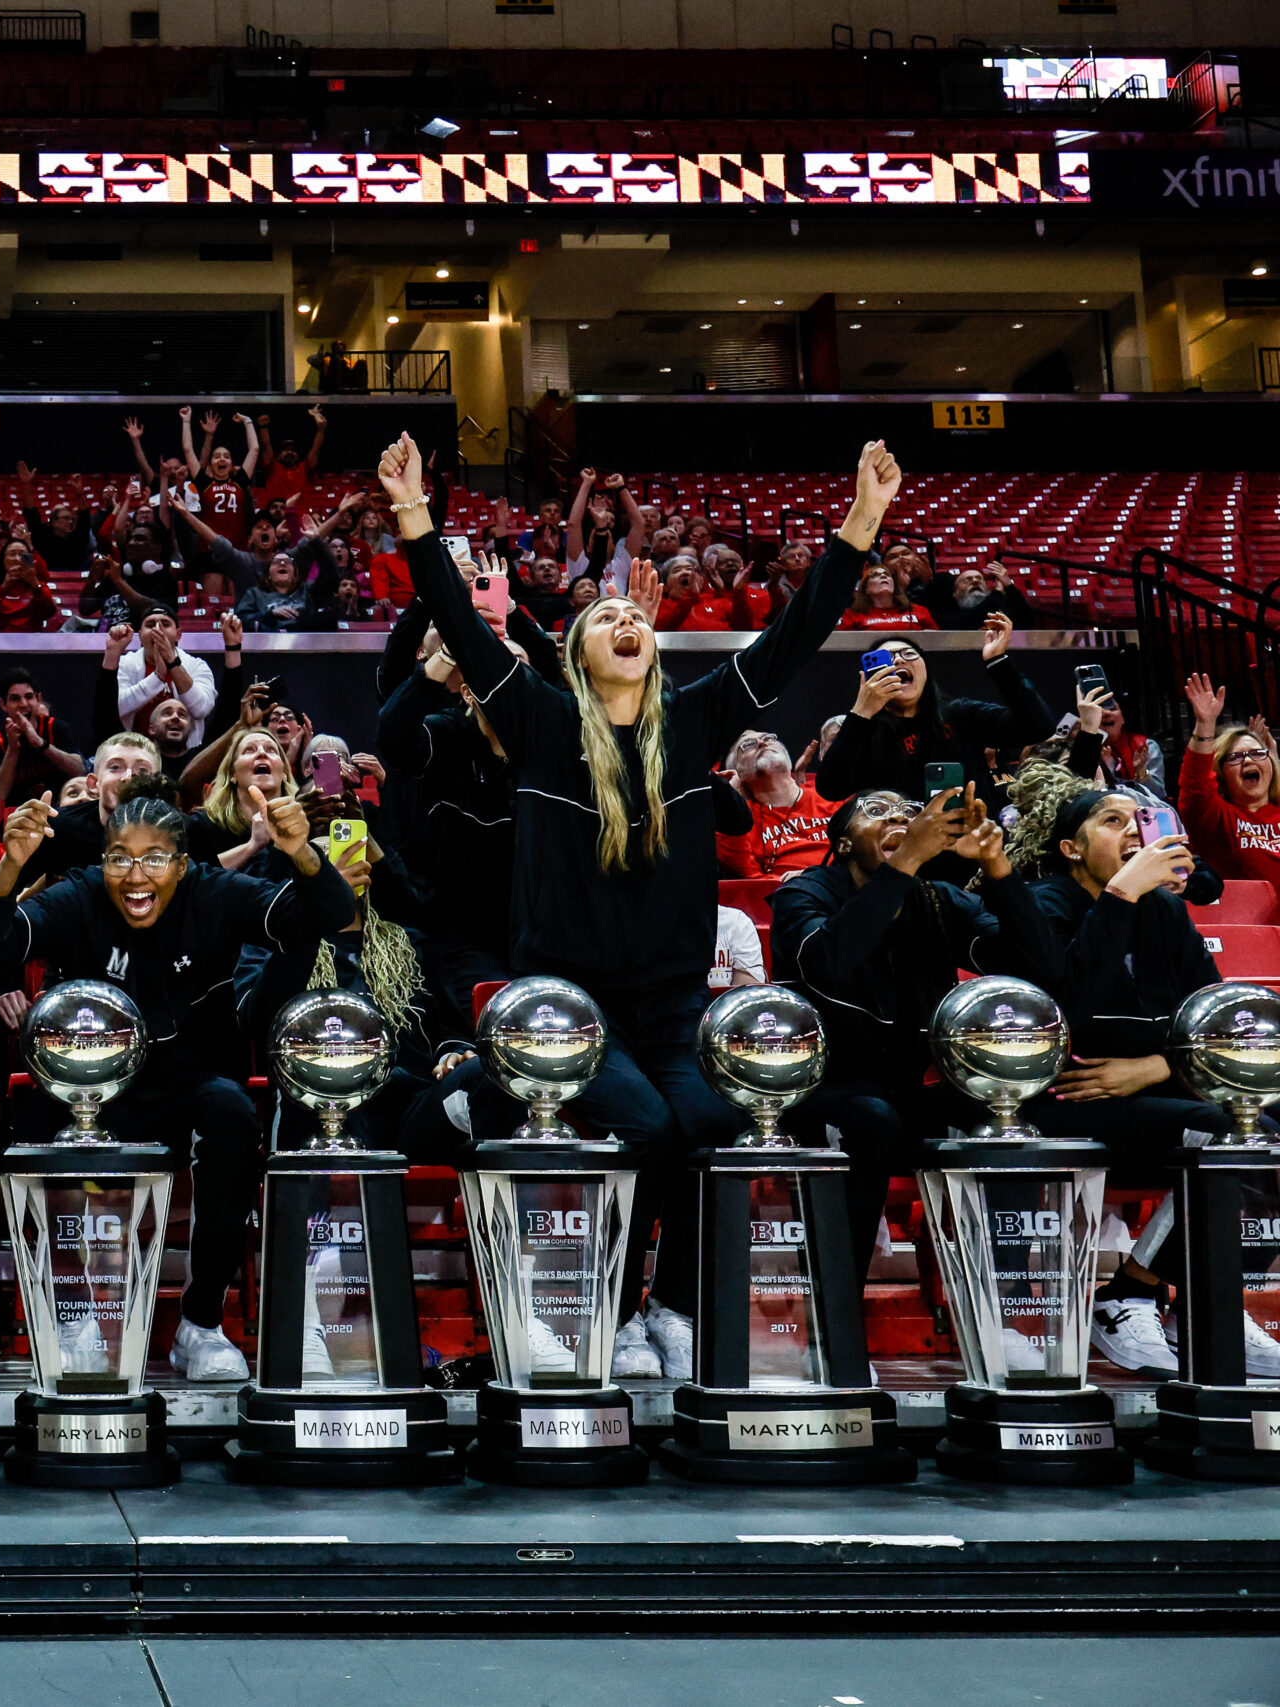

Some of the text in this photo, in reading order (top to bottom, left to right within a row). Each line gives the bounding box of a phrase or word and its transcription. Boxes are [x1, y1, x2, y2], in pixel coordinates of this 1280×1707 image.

[946, 405, 991, 426] 113
[214, 493, 238, 513] 24
[52, 1275, 85, 1283] WOMEN'S
[526, 1271, 600, 1279] OMEN'S BASKETBALL
[992, 1272, 1073, 1280] WOMEN'S BASKETBALL
[314, 1287, 365, 1295] CHAMPIONS
[754, 1287, 810, 1295] CHAMPIONS
[530, 1296, 595, 1304] TOURNAMENT
[1000, 1297, 1069, 1305] TOURNAMENT
[57, 1301, 126, 1309] TOURNAMENT
[59, 1311, 123, 1320] CHAMPIONS
[532, 1307, 593, 1315] CHAMPIONS
[1004, 1308, 1066, 1316] CHAMPIONS
[326, 1324, 353, 1333] 2020
[771, 1324, 798, 1333] 2017
[555, 1335, 581, 1346] 017
[302, 1421, 400, 1437] MARYLAND
[530, 1419, 622, 1436] MARYLAND
[739, 1421, 863, 1437] MARYLAND
[43, 1428, 142, 1440] MARYLAND
[1019, 1433, 1102, 1446] MARYLAND
